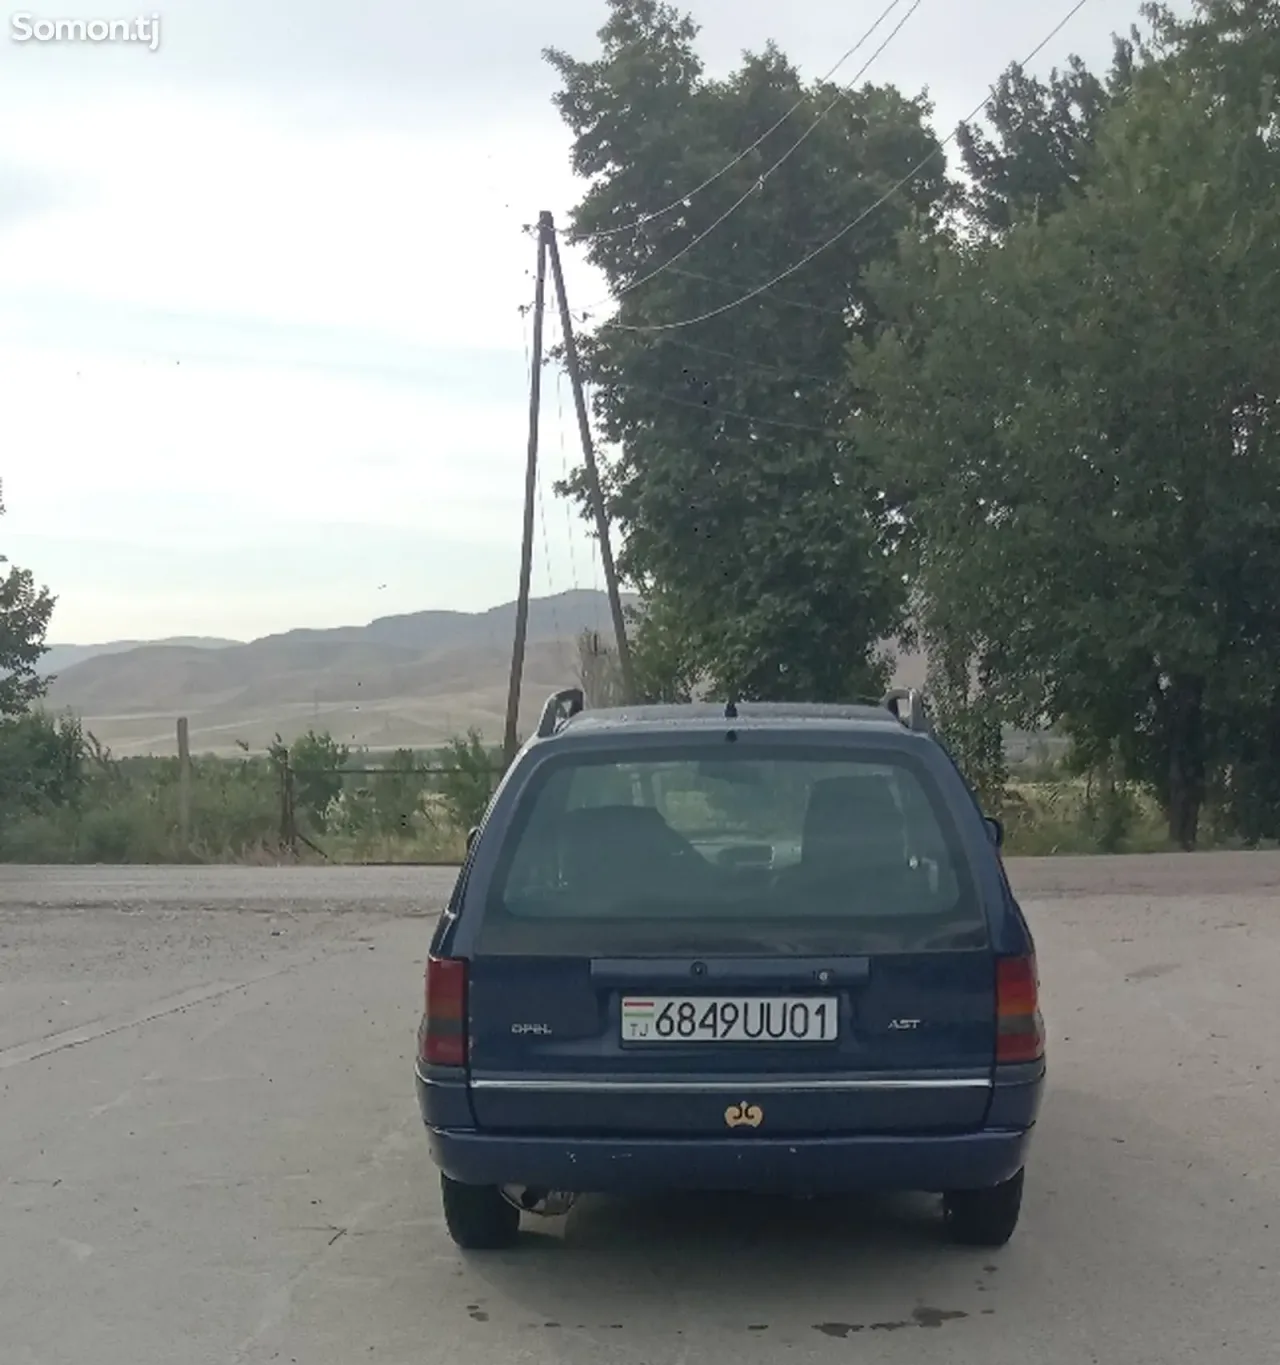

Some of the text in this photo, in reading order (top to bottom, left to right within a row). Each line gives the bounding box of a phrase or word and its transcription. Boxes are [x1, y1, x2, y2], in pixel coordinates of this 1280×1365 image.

[655, 1001, 827, 1038] 6849UU01
[511, 1023, 552, 1034] OPEL
[630, 1023, 649, 1037] TJ
